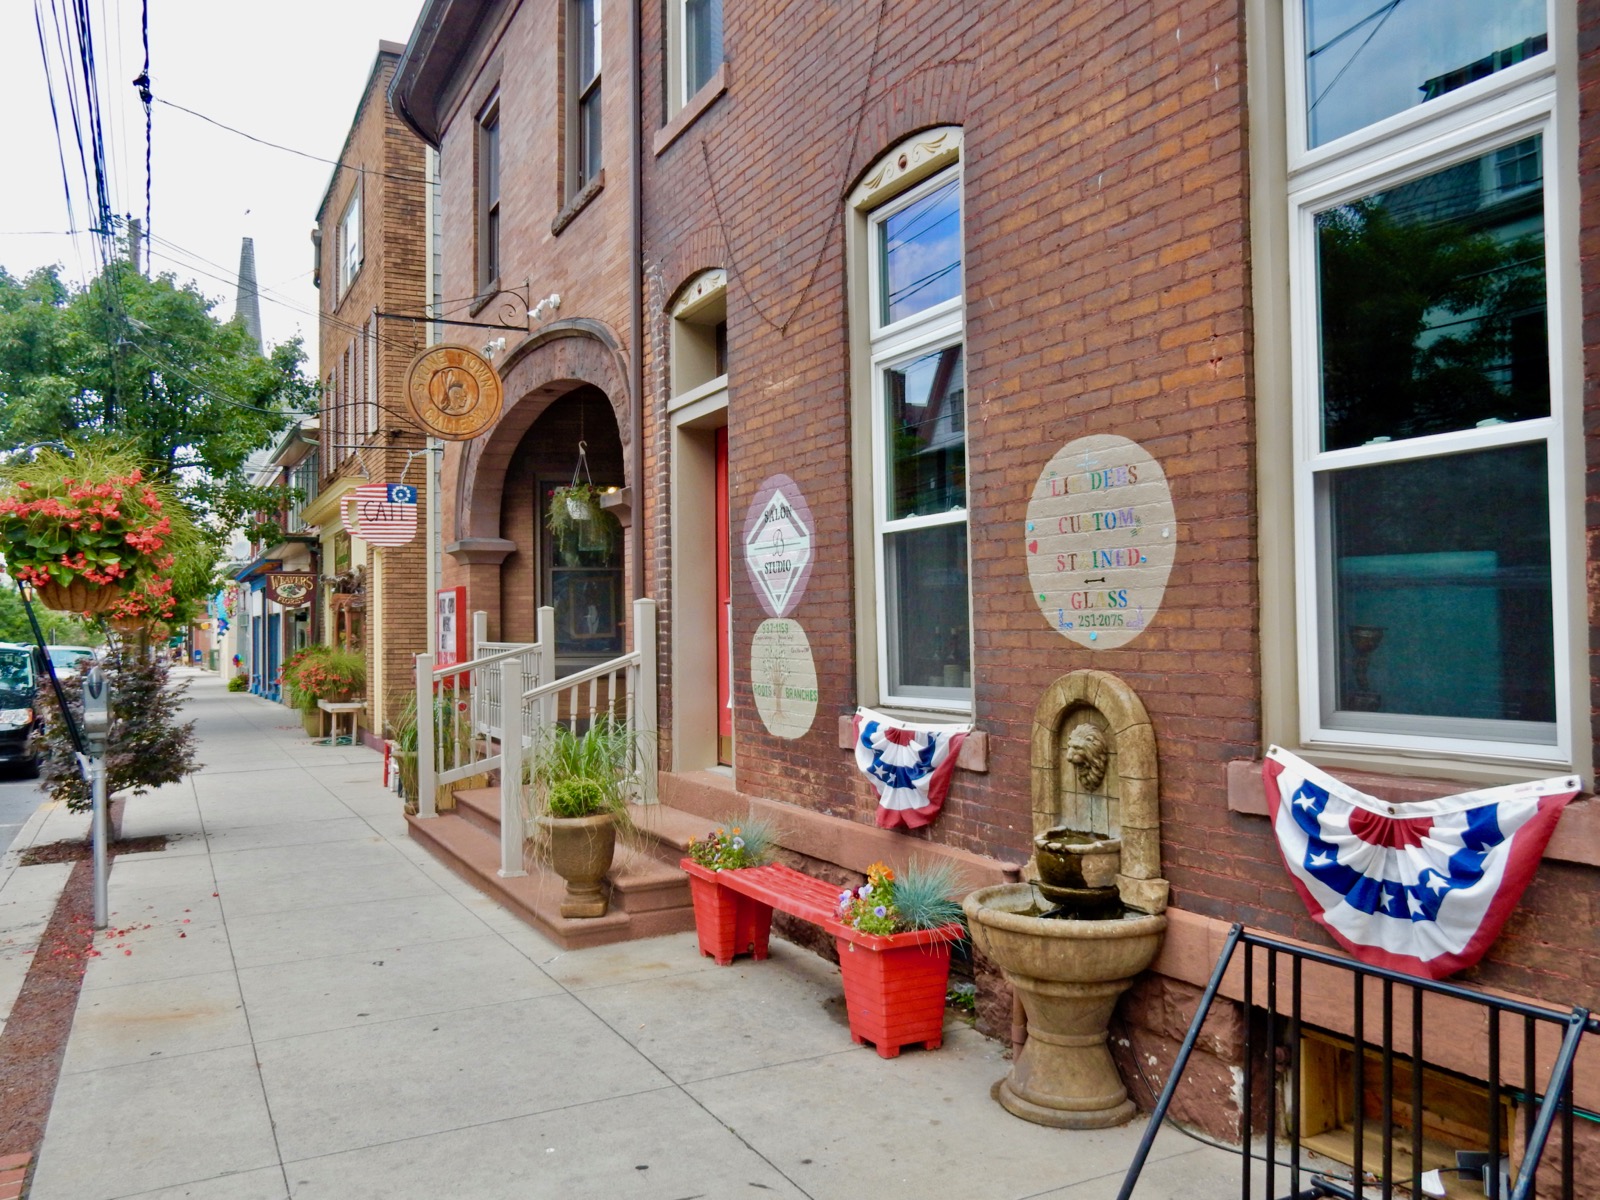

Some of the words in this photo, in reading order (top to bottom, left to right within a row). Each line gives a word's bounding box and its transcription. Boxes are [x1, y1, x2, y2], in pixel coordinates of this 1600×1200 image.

[412, 350, 449, 391] STONE
[461, 353, 495, 390] TOWN
[424, 409, 486, 433] GALLERY
[764, 504, 792, 523] SALON
[1059, 508, 1135, 534] CUSTOM
[764, 559, 792, 575] STUDIO
[1057, 548, 1140, 572] STAINED
[277, 596, 305, 605] FLORIST
[1071, 589, 1128, 609] GLASS
[1078, 613, 1124, 628] 251-2075
[753, 684, 772, 698] ROOTS
[785, 687, 818, 702] BRANCHES
